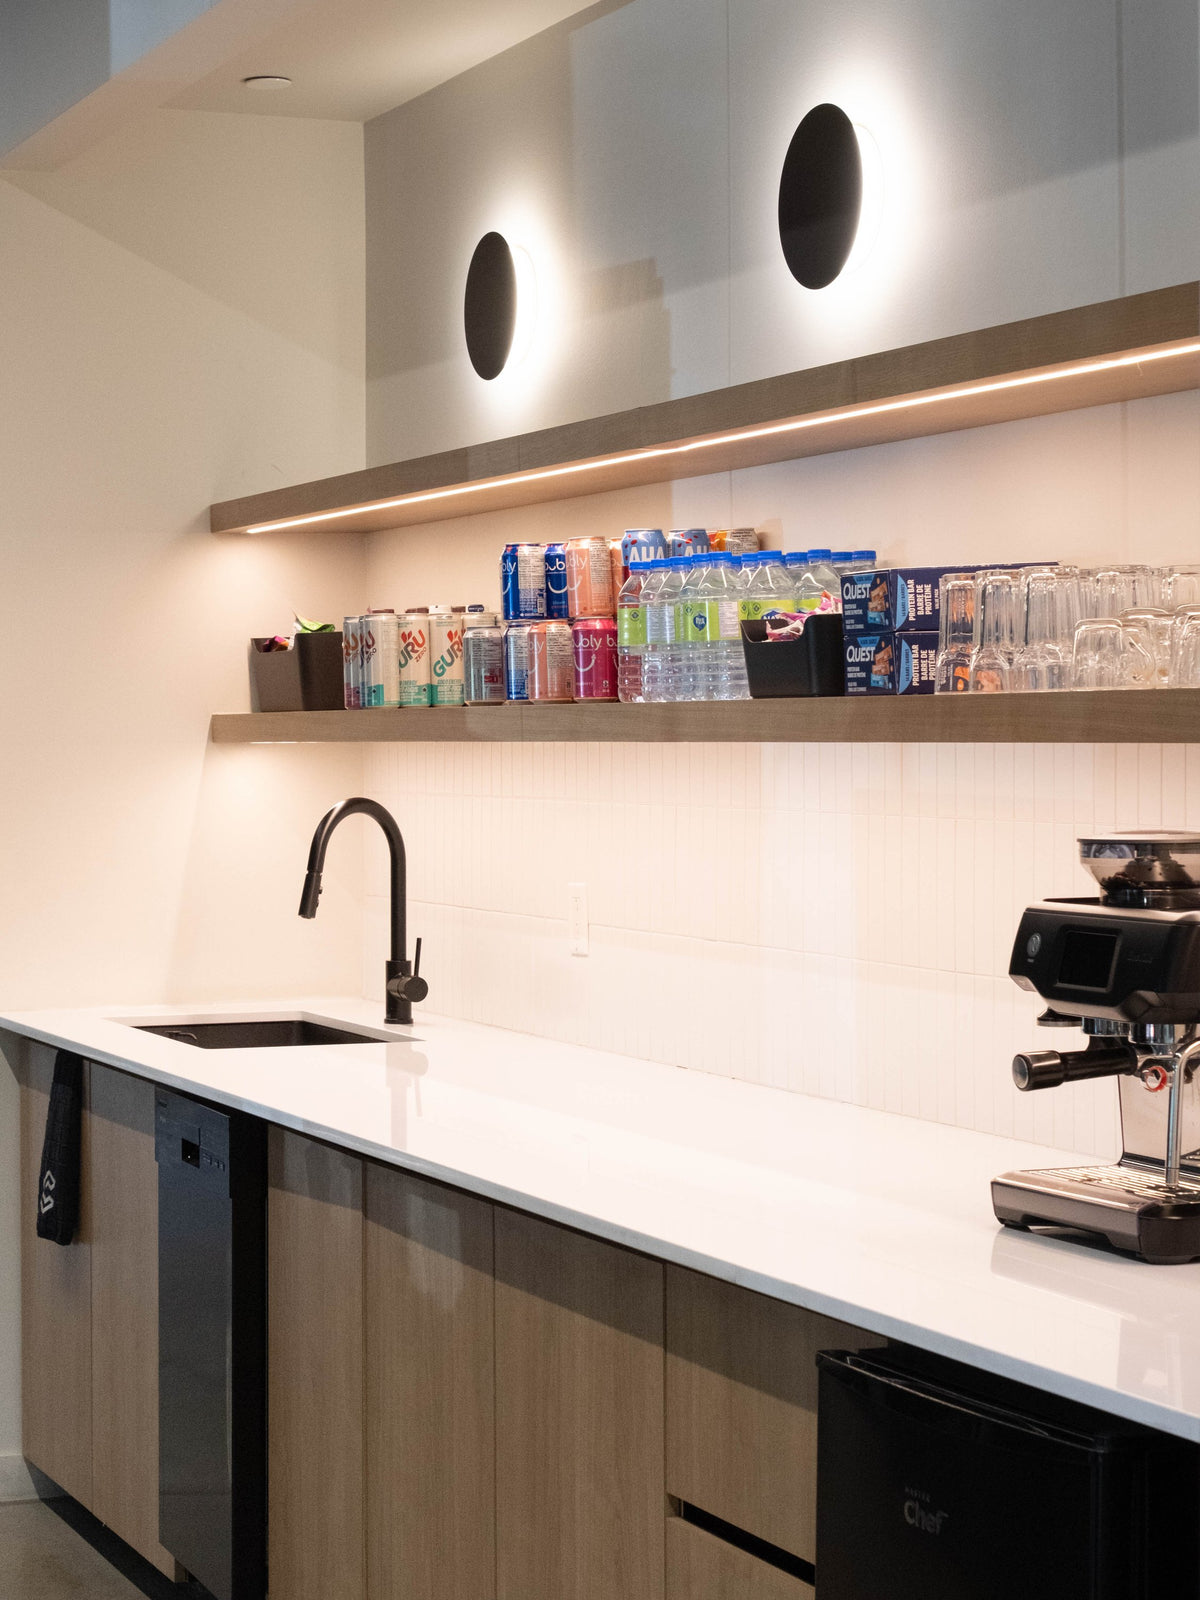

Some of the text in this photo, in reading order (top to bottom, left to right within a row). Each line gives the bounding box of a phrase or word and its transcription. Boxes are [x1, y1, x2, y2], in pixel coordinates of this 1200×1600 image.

[843, 583, 871, 600] QUEST
[907, 579, 916, 621] PROTEIN BAR
[916, 584, 925, 615] BARRE DE
[399, 629, 426, 669] URU
[846, 645, 876, 662] QUEST
[911, 644, 920, 686] PROTEIN BAR
[920, 649, 928, 681] BARRE DE
[904, 1500, 949, 1536] Chef
